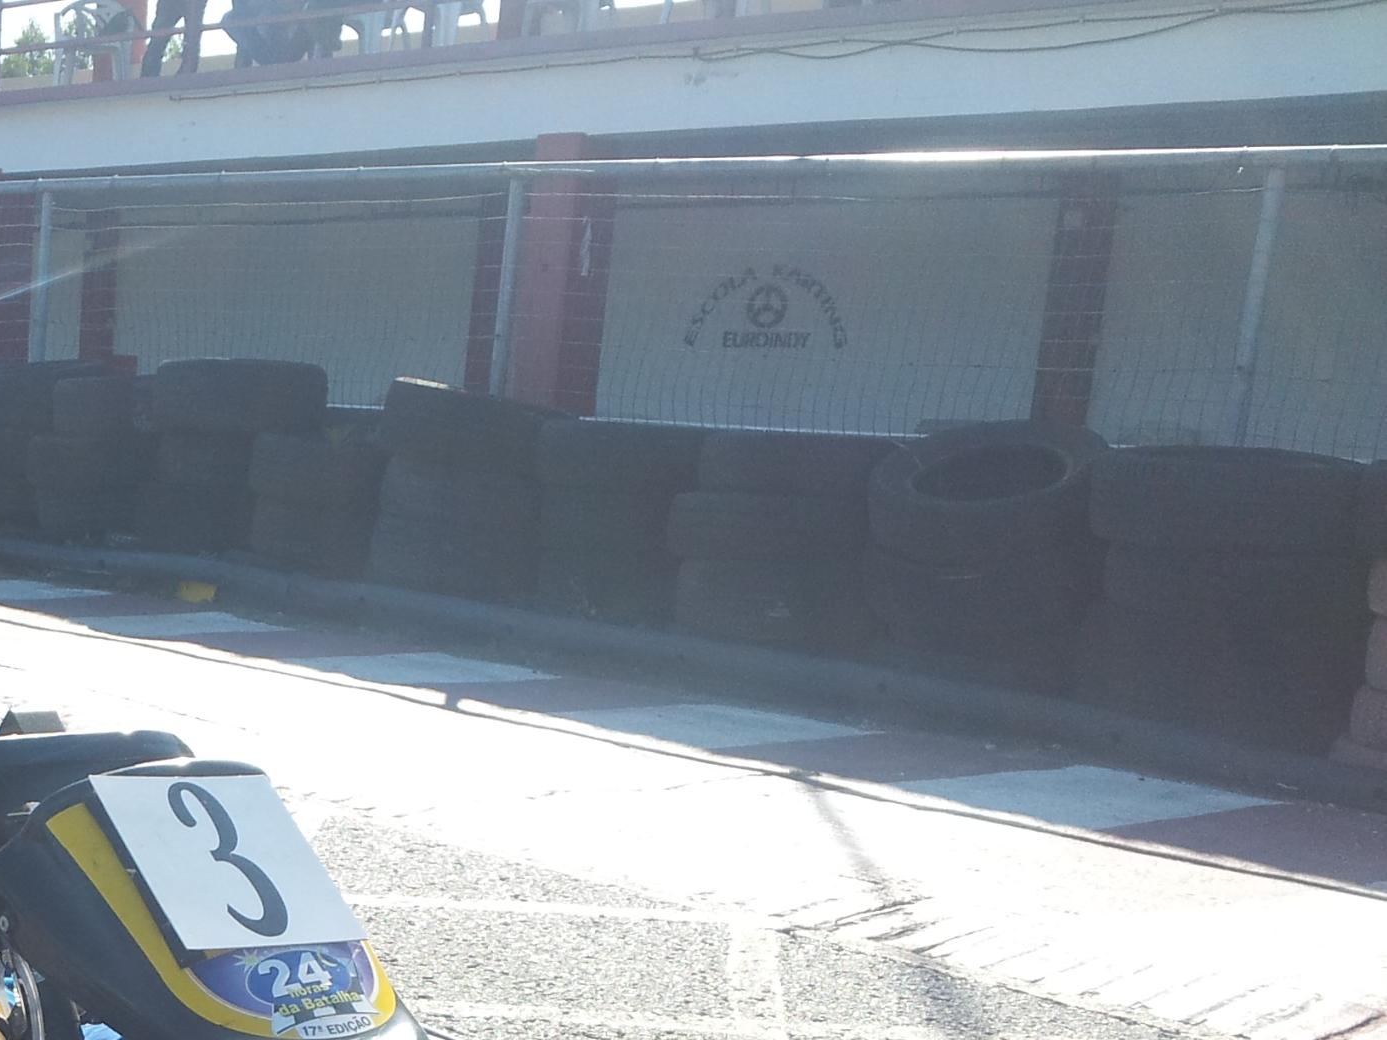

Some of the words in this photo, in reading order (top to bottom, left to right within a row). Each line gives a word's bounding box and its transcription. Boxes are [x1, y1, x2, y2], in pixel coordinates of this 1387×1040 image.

[684, 267, 757, 347] ESCOLA
[773, 264, 848, 349] KARTING
[722, 331, 812, 348] EUROINDY
[167, 781, 289, 938] 3
[258, 951, 333, 998] 24
[279, 1001, 298, 1018] da
[303, 989, 360, 1013] Batalha
[288, 980, 333, 999] horas
[301, 1023, 324, 1037] 17ª
[327, 1014, 372, 1035] EDIÇÃO
